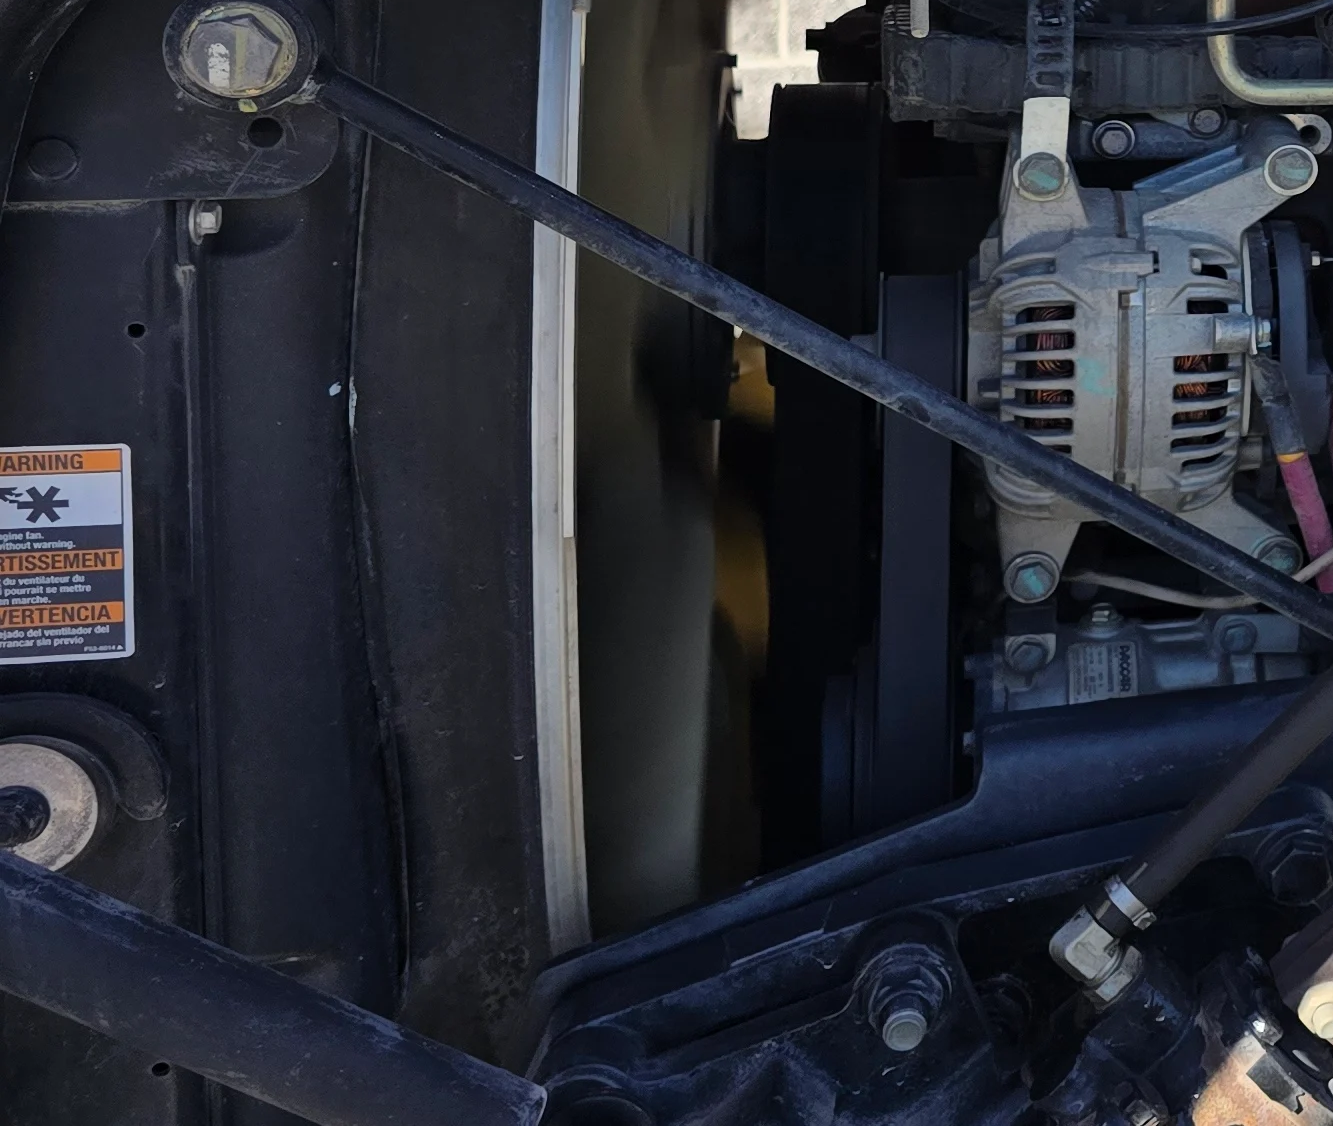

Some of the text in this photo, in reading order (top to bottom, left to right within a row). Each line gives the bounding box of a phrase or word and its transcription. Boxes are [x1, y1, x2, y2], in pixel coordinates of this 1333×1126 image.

[0, 453, 84, 472] ARNING
[26, 531, 44, 540] fan.
[33, 539, 76, 549] warning.
[3, 574, 85, 586] du ventilateur du
[4, 584, 92, 597] pourrait se mettre
[12, 595, 51, 605] marche.
[27, 628, 42, 637] del
[44, 626, 92, 636] ventilador
[94, 624, 110, 634] del
[36, 637, 51, 646] sin
[54, 636, 85, 647] previo
